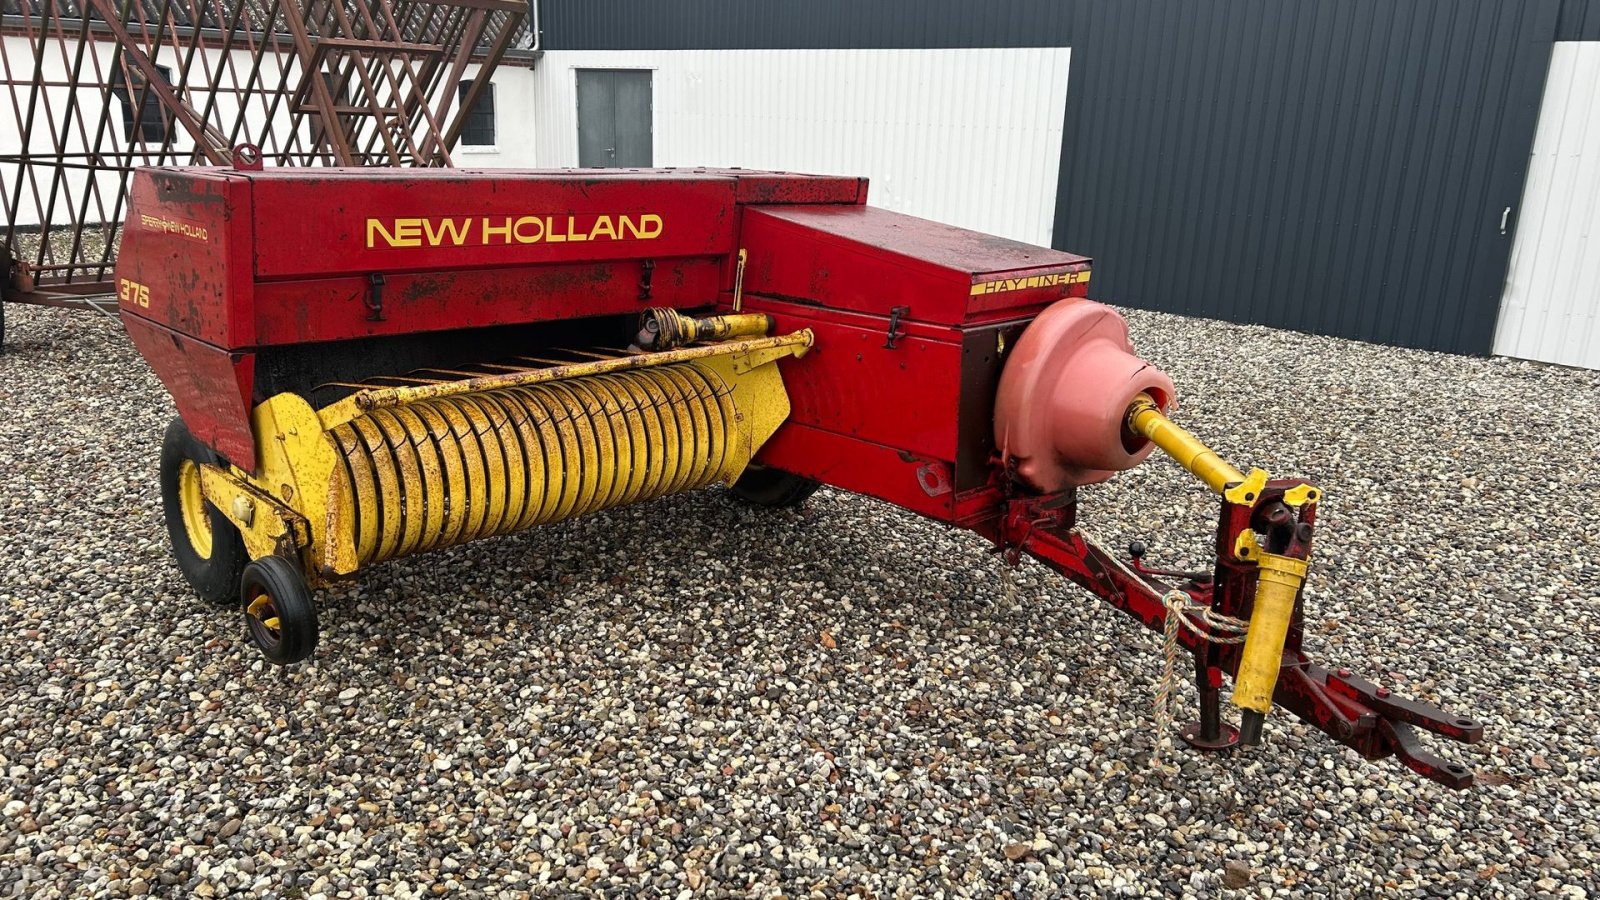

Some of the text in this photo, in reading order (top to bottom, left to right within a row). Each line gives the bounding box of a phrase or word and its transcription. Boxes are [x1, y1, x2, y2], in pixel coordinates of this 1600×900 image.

[141, 214, 208, 241] SPERRY NEW HOLLAND
[366, 213, 664, 248] NEW HOLLAND
[120, 278, 150, 309] 375
[985, 272, 1080, 294] HAYLINER
